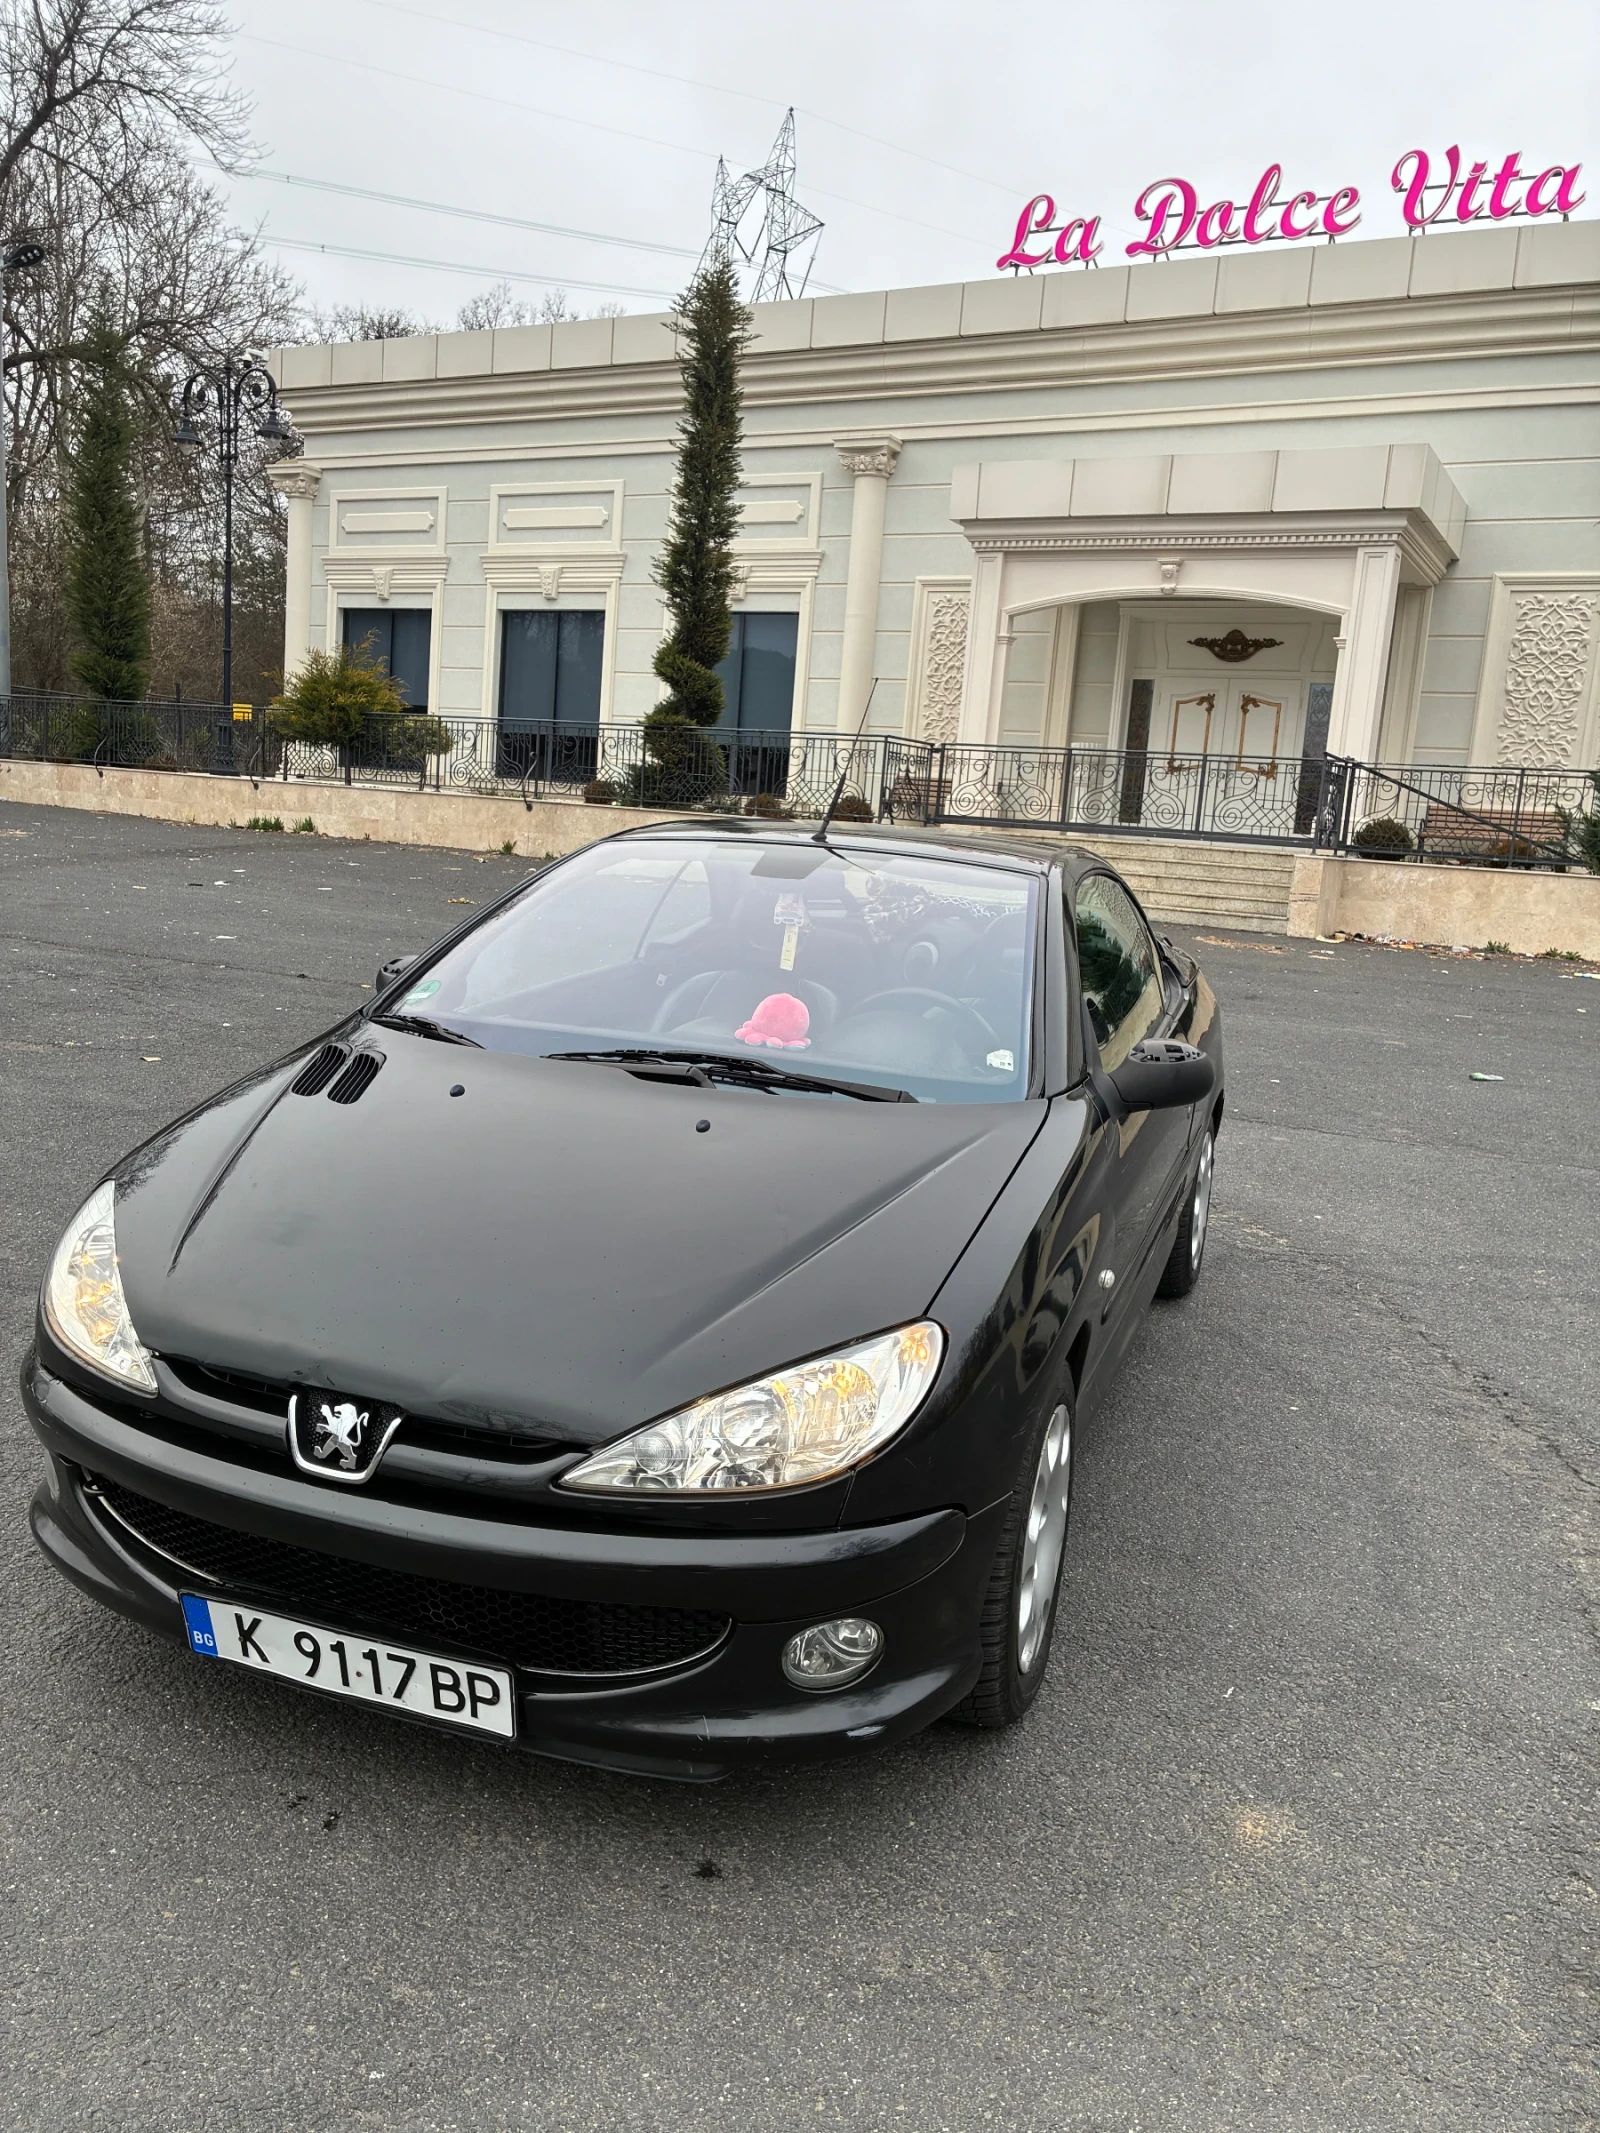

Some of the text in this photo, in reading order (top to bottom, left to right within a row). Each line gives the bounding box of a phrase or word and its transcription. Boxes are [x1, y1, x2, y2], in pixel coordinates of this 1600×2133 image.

[996, 144, 1586, 270] La Dolce Vita
[193, 1630, 214, 1647] BG
[234, 1612, 501, 1719] K 9117 BP
